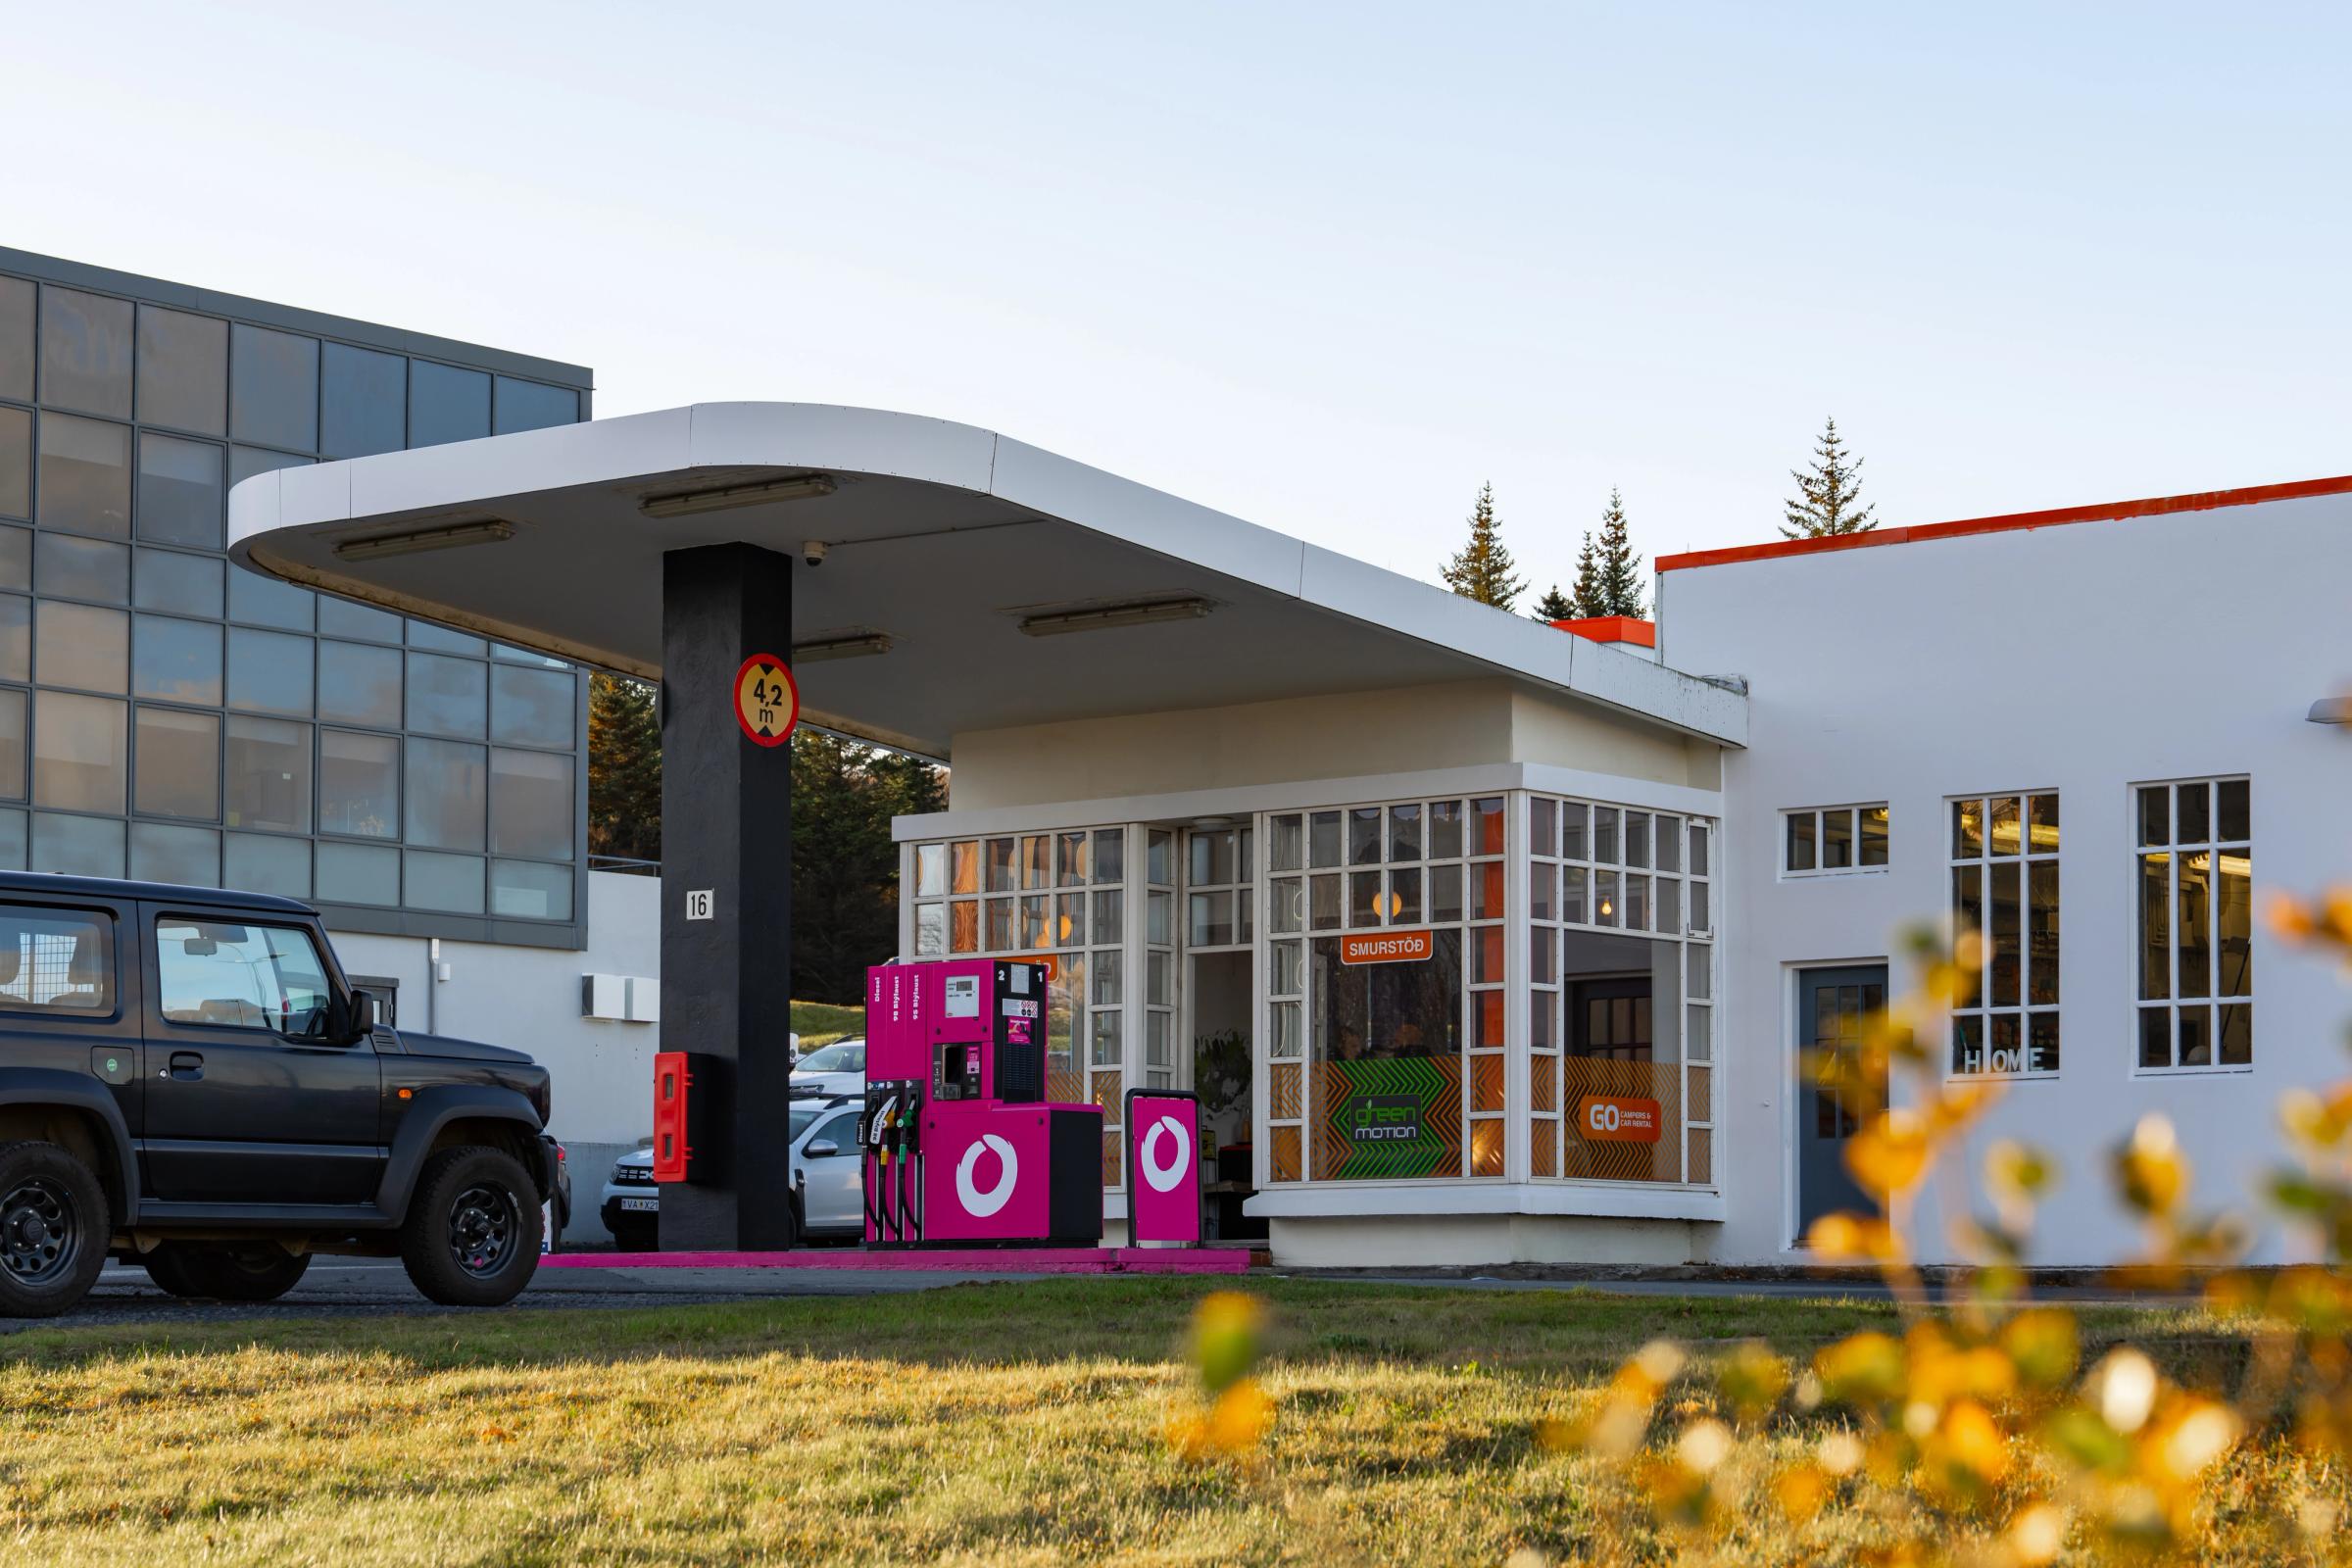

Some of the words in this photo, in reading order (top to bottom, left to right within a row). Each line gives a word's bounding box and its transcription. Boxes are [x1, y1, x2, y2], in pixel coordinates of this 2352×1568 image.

[754, 678, 782, 707] 4,2
[759, 709, 774, 723] m
[691, 894, 707, 916] 16
[1349, 936, 1424, 956] SMURSTÖÐ
[999, 969, 1005, 981] 2
[1038, 971, 1044, 983] 1
[1964, 1048, 2045, 1074] HOME
[1355, 1106, 1416, 1127] green
[1590, 1104, 1620, 1132] GO
[1620, 1110, 1646, 1120] CAMPERS
